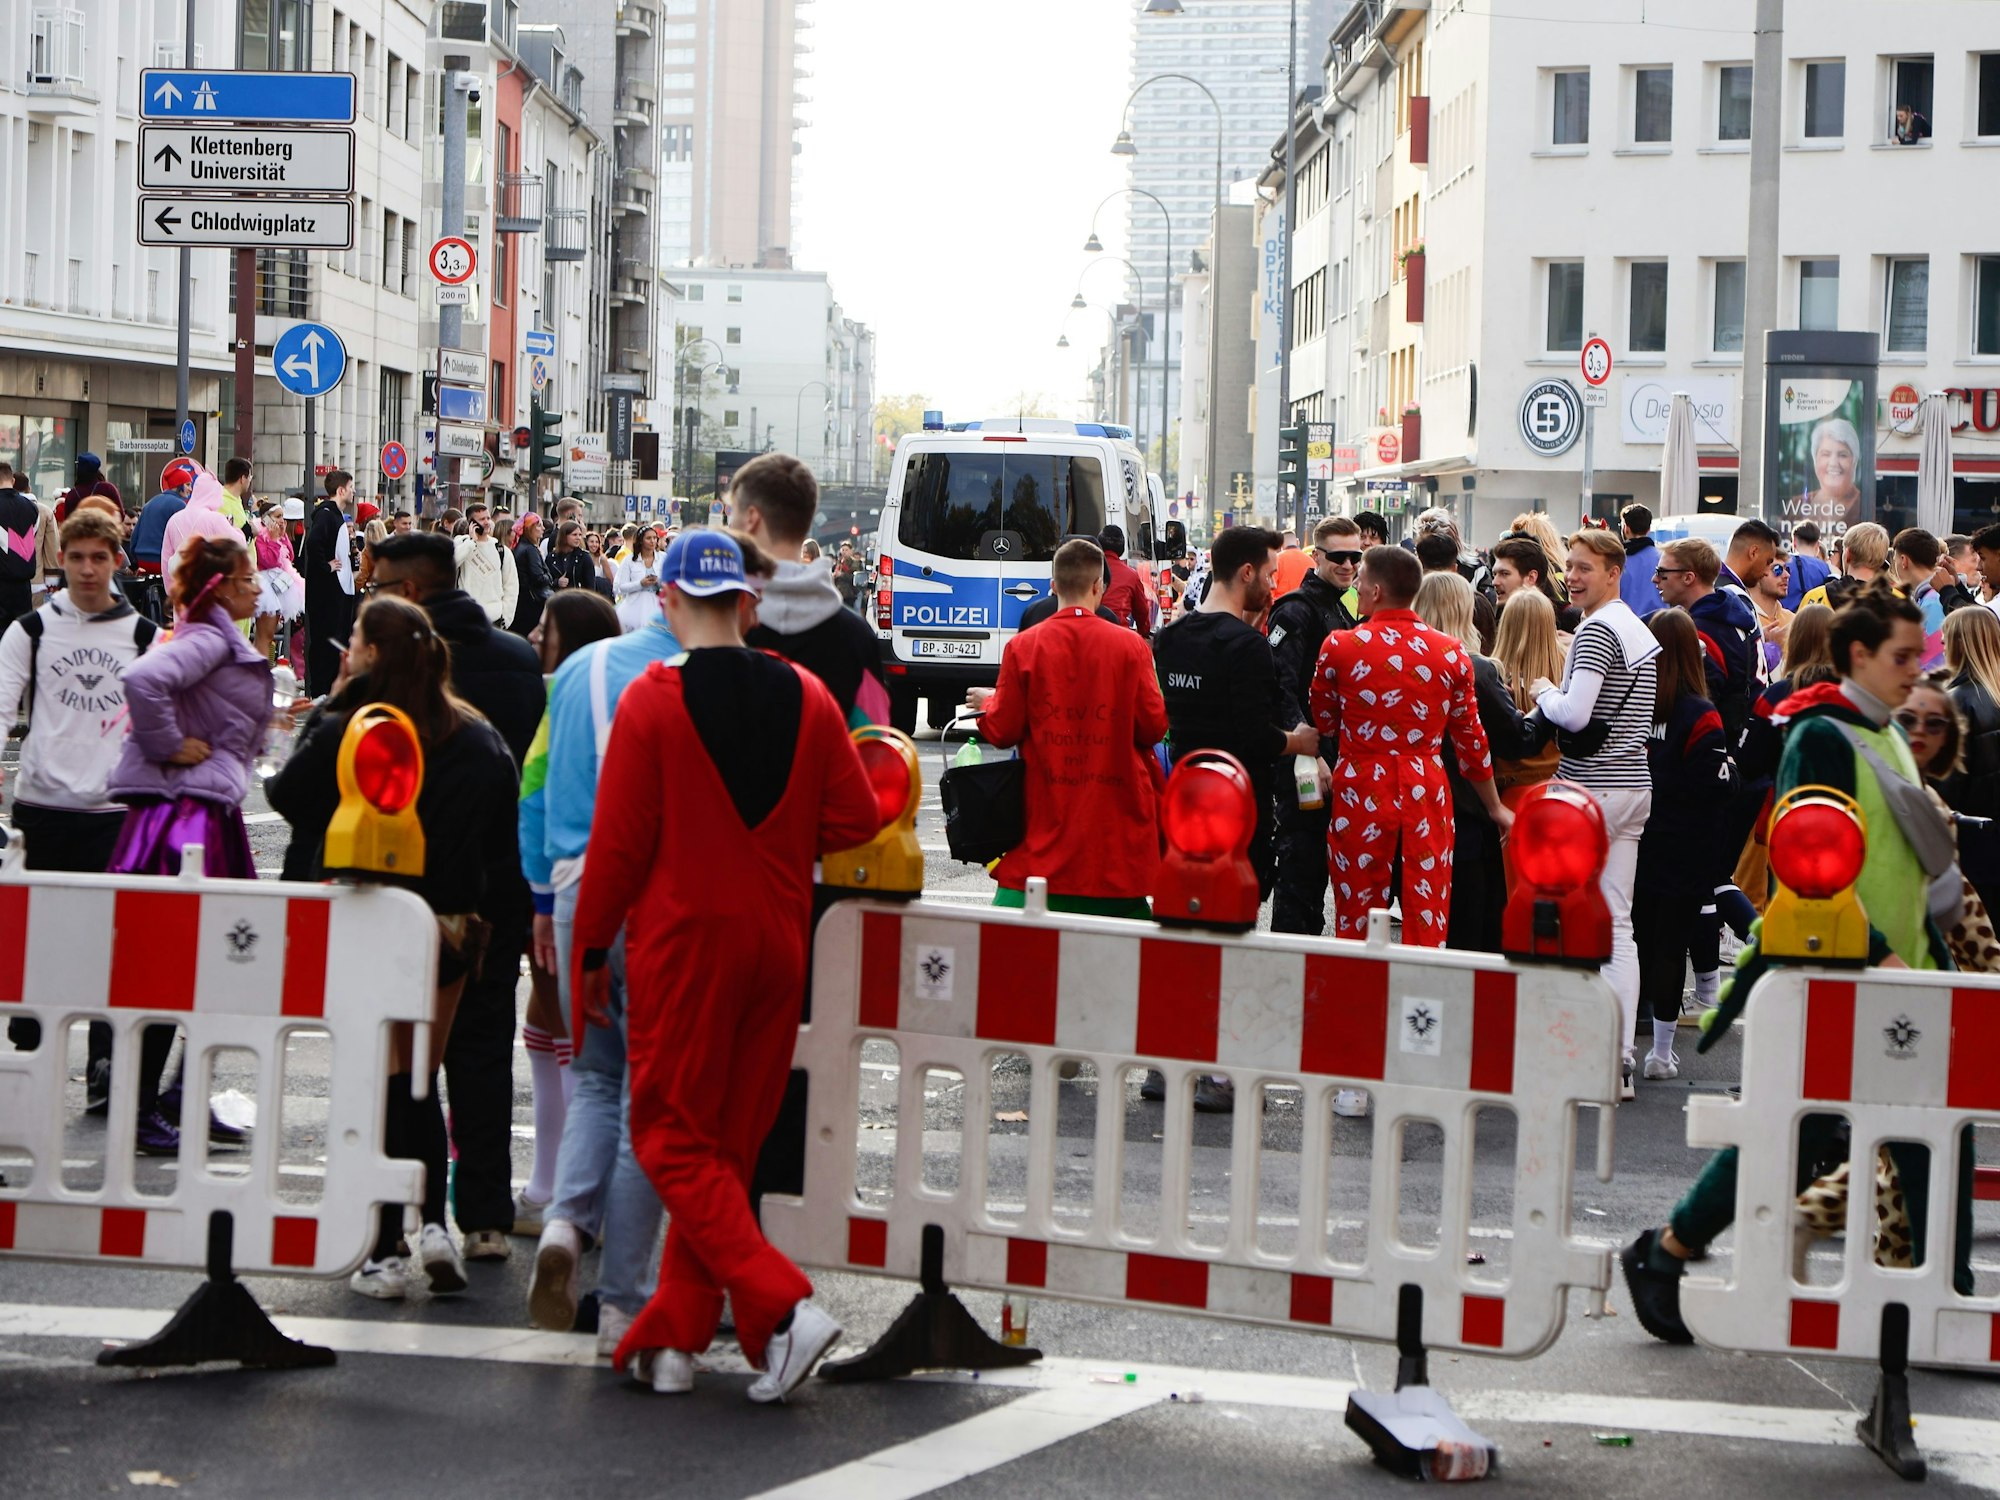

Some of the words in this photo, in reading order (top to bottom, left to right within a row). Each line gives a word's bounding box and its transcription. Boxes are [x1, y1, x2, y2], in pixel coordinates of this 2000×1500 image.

[191, 135, 293, 160] Klettenberg
[191, 160, 286, 181] Universität
[191, 210, 316, 236] Chlodwigplatz
[1264, 240, 1277, 314] OPTIK
[440, 291, 456, 300] 200
[457, 292, 466, 300] m
[451, 359, 479, 376] Chlodwigplatz
[1586, 394, 1598, 402] 200
[1536, 402, 1561, 432] 5
[1892, 406, 1914, 420] früh
[617, 396, 626, 456] SPORTWETTEN
[1308, 425, 1333, 436] NESS
[119, 440, 169, 452] Barbarossaplatz
[451, 435, 475, 450] Klettenberg
[1531, 436, 1567, 449] COLOGNE
[1781, 499, 1846, 517] Werde
[903, 605, 989, 625] POLIZEI
[1168, 672, 1203, 690] SWAT
[53, 688, 123, 712] ARMANI
[1717, 761, 1732, 782] 4
